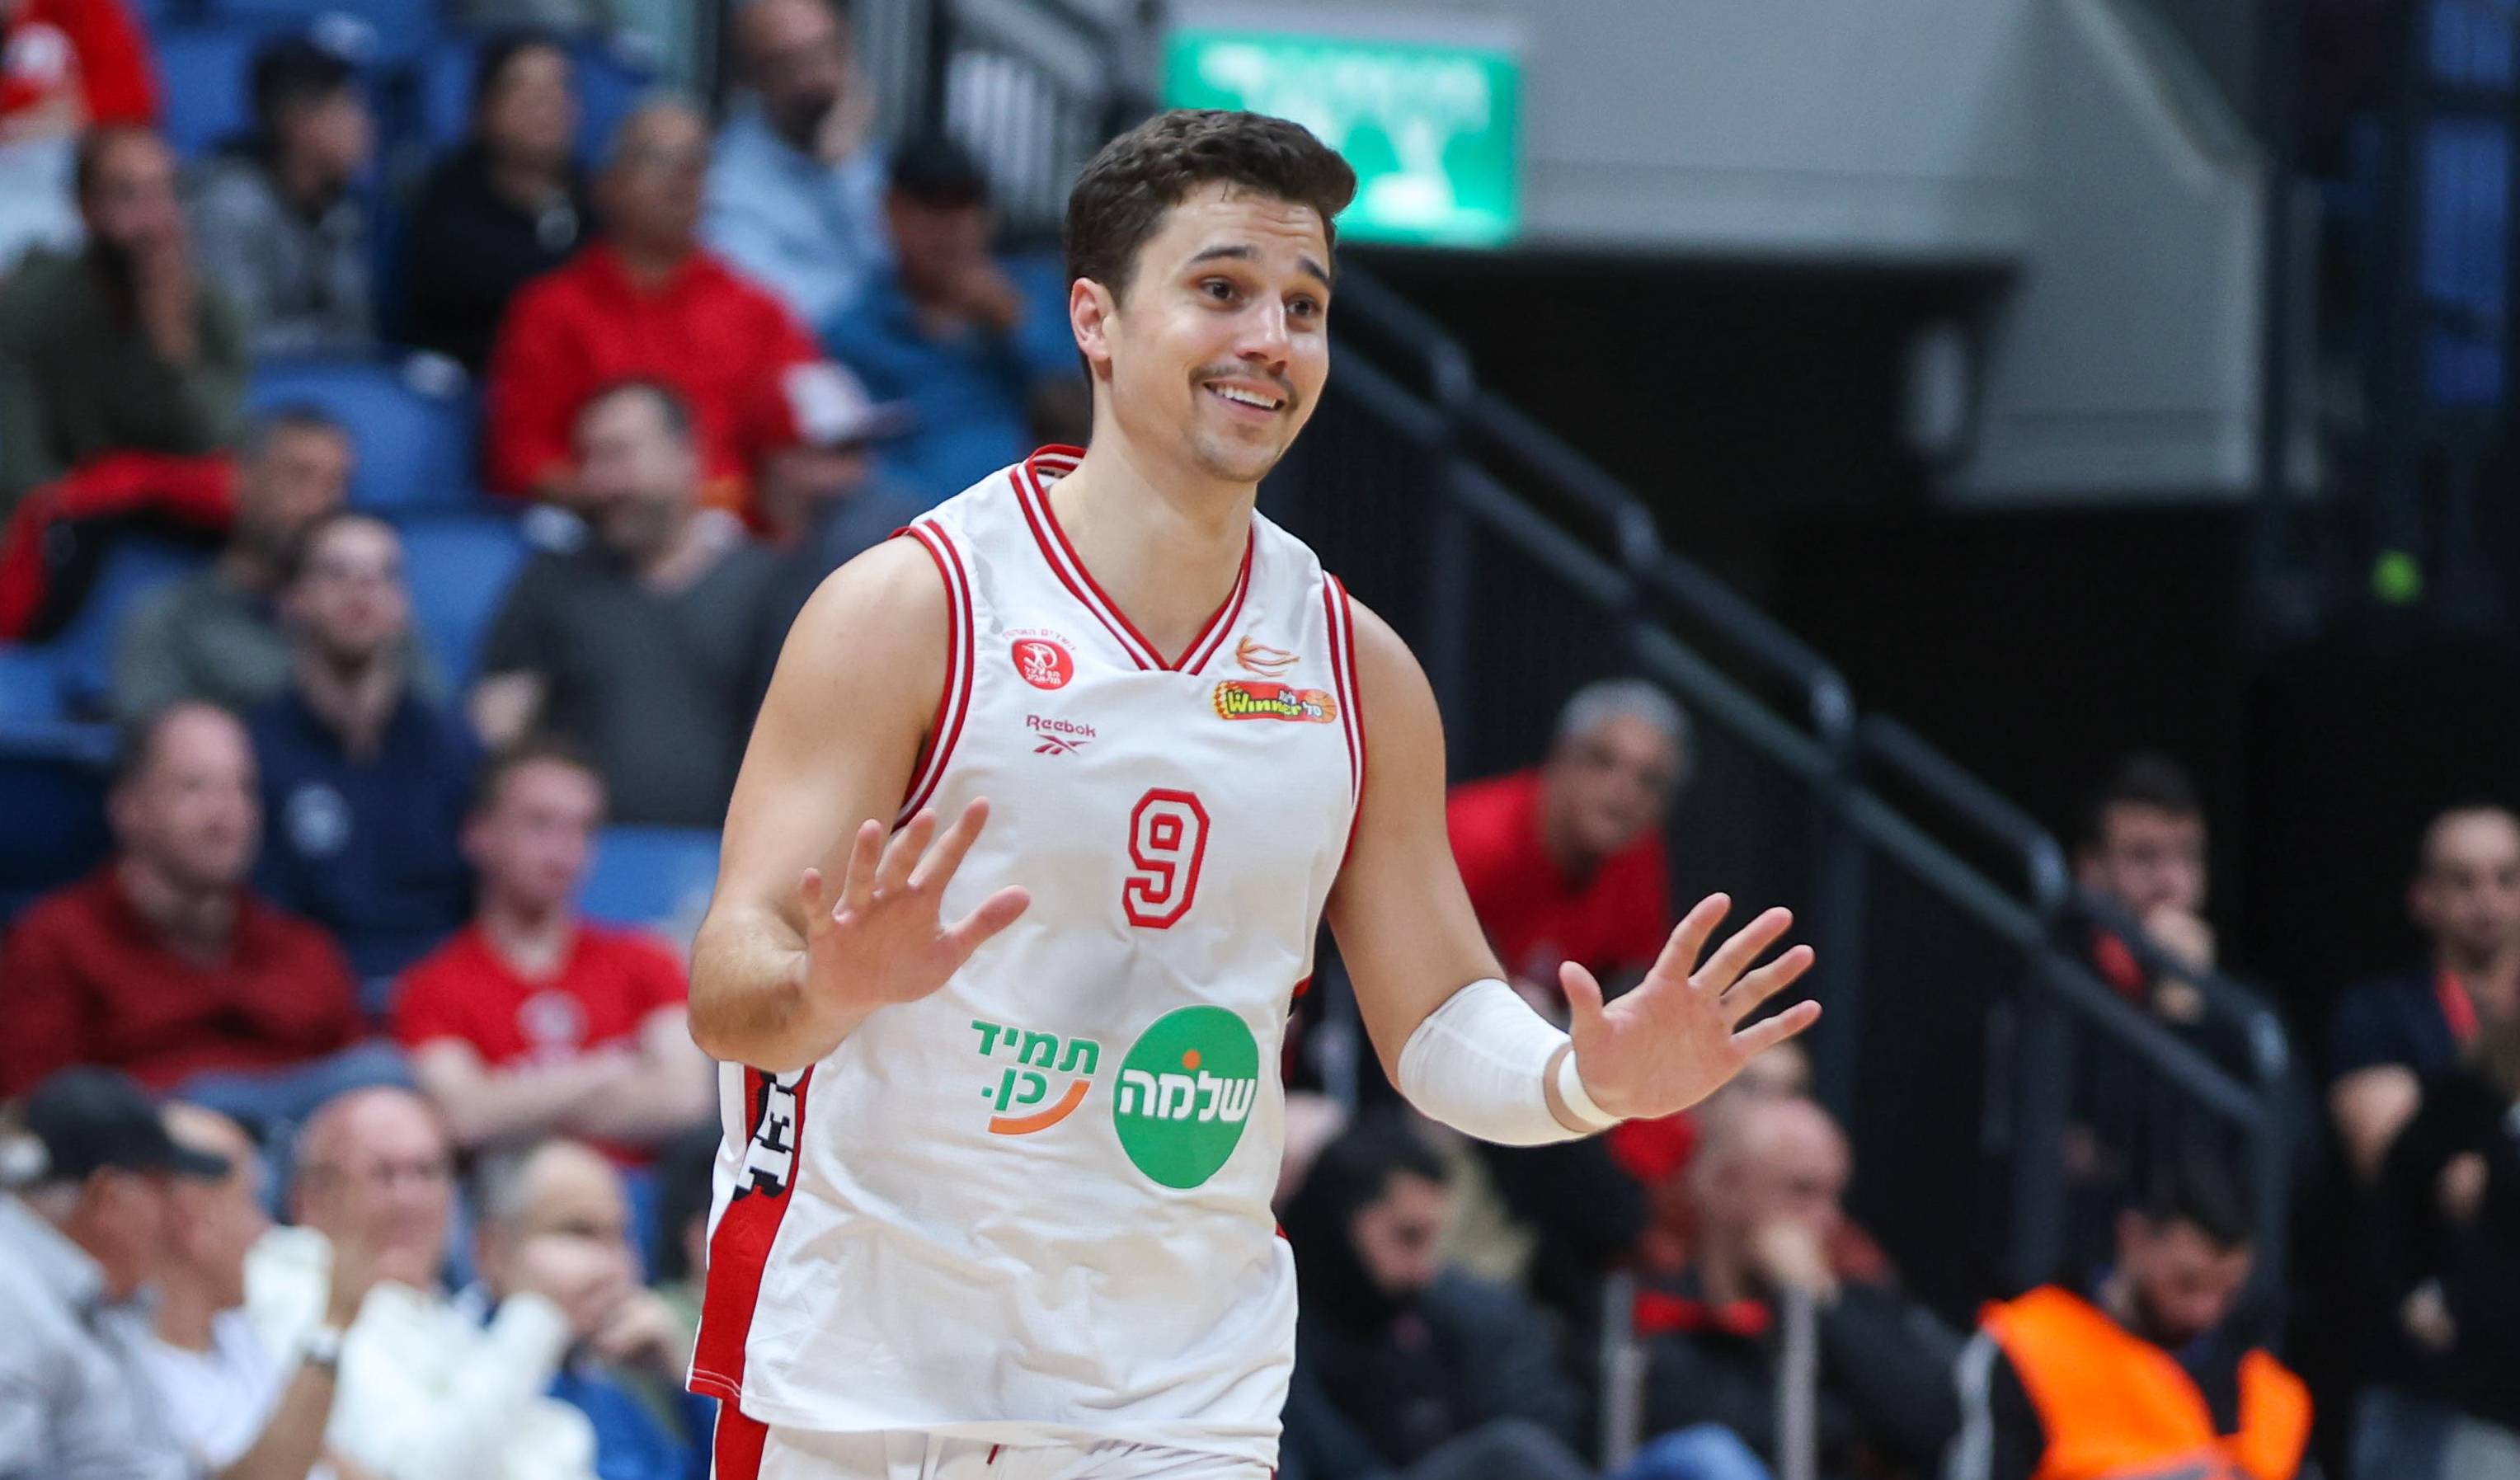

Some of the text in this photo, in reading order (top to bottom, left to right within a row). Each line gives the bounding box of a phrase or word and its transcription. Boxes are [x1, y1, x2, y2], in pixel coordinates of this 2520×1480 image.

[1026, 714, 1096, 737] Reebok
[1225, 689, 1303, 717] Winner
[1121, 787, 1210, 930] 9
[971, 1019, 1100, 1074] תמיד
[980, 1067, 1047, 1111] כן.
[1118, 1069, 1255, 1122] שלמה
